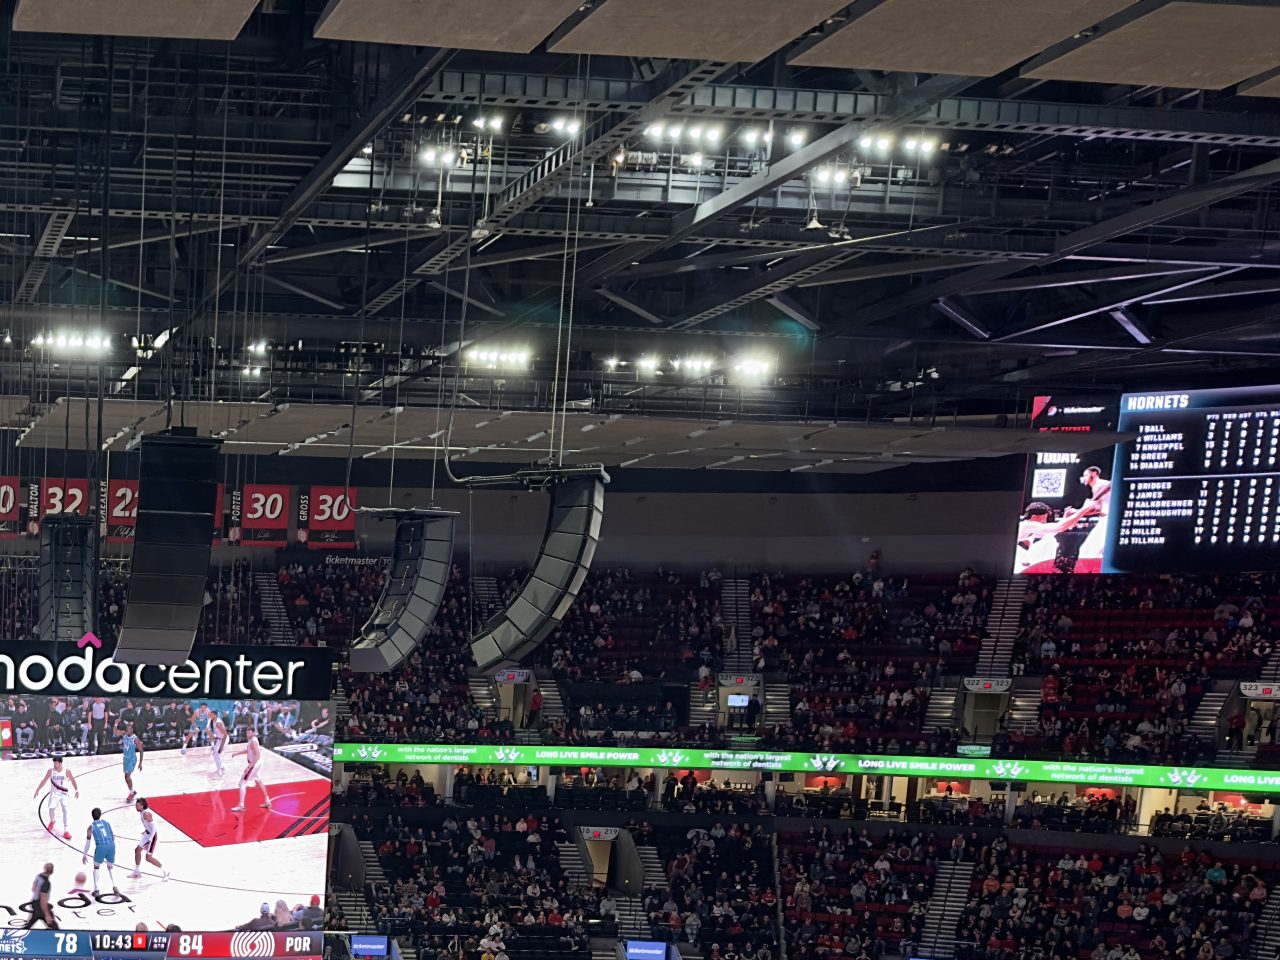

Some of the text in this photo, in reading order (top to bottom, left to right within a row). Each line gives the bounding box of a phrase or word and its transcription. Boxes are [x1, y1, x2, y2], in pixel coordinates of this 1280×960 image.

[1128, 395, 1189, 410] HORNETS
[1145, 425, 1165, 433] BALL
[1143, 433, 1183, 442] WILLIAMS
[1142, 443, 1184, 451] KNUEPPEL
[1141, 452, 1167, 460] GREEN
[1129, 461, 1174, 470] 14 DIABATE
[1137, 482, 1172, 490] BRIDGES
[1136, 491, 1163, 499] JAMES
[28, 484, 39, 518] WALTON
[45, 486, 83, 515] 32
[231, 490, 241, 521] PORTER
[1135, 499, 1193, 508] KALKBRENNER
[246, 493, 283, 519] 30
[299, 495, 309, 521] GROSS
[314, 494, 350, 521] 30
[1134, 509, 1193, 517] CONNAUGHTON
[1133, 518, 1156, 526] MANN
[1132, 527, 1161, 535] MILLER
[1119, 536, 1165, 545] 26 TILLMAN
[325, 555, 378, 565] ticketmaster
[858, 760, 976, 771] LONG LIVE SMILE POWER
[54, 933, 78, 953] 78
[95, 935, 132, 949] 10:43
[179, 934, 203, 955] 84
[285, 937, 311, 952] POR
